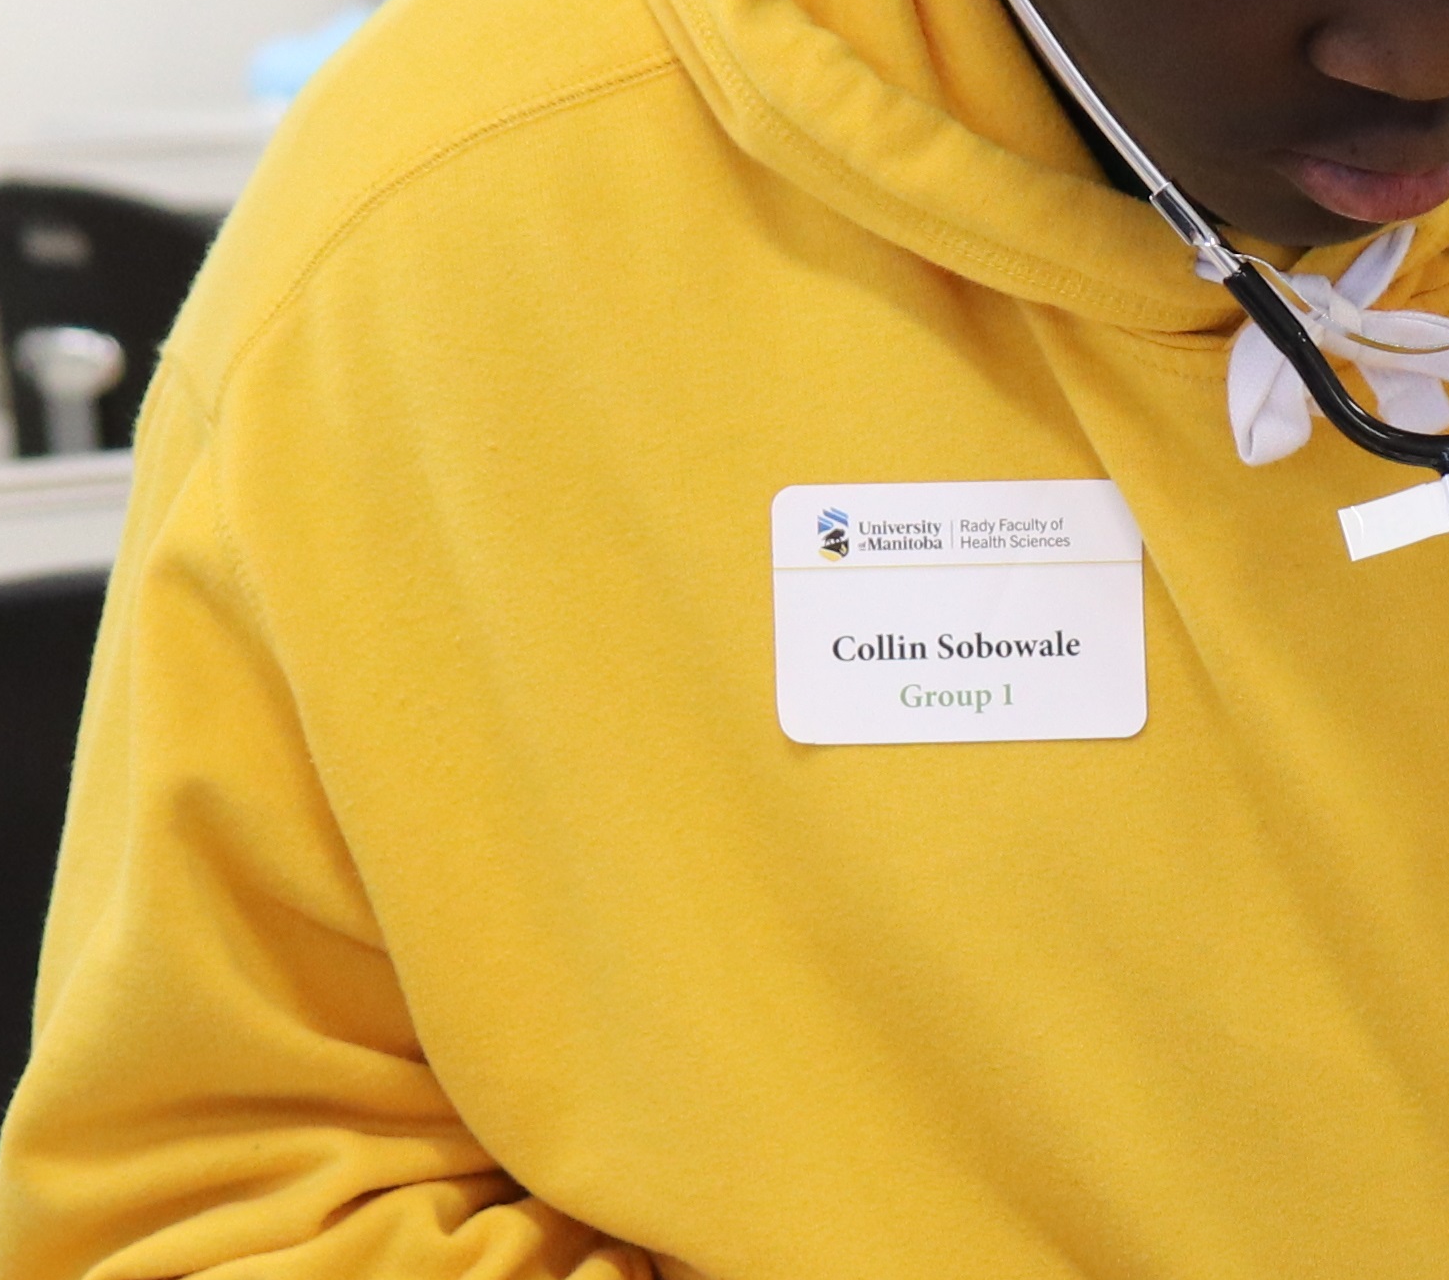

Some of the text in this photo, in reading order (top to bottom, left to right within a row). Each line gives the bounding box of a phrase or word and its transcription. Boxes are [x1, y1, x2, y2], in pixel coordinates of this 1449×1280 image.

[858, 520, 942, 537] University
[960, 517, 1064, 534] Rady Faculty of
[867, 535, 943, 551] Manitoba
[960, 534, 1071, 549] Health Sciences
[832, 630, 1081, 662] Collin Sobowale
[899, 683, 1014, 713] Group 1
